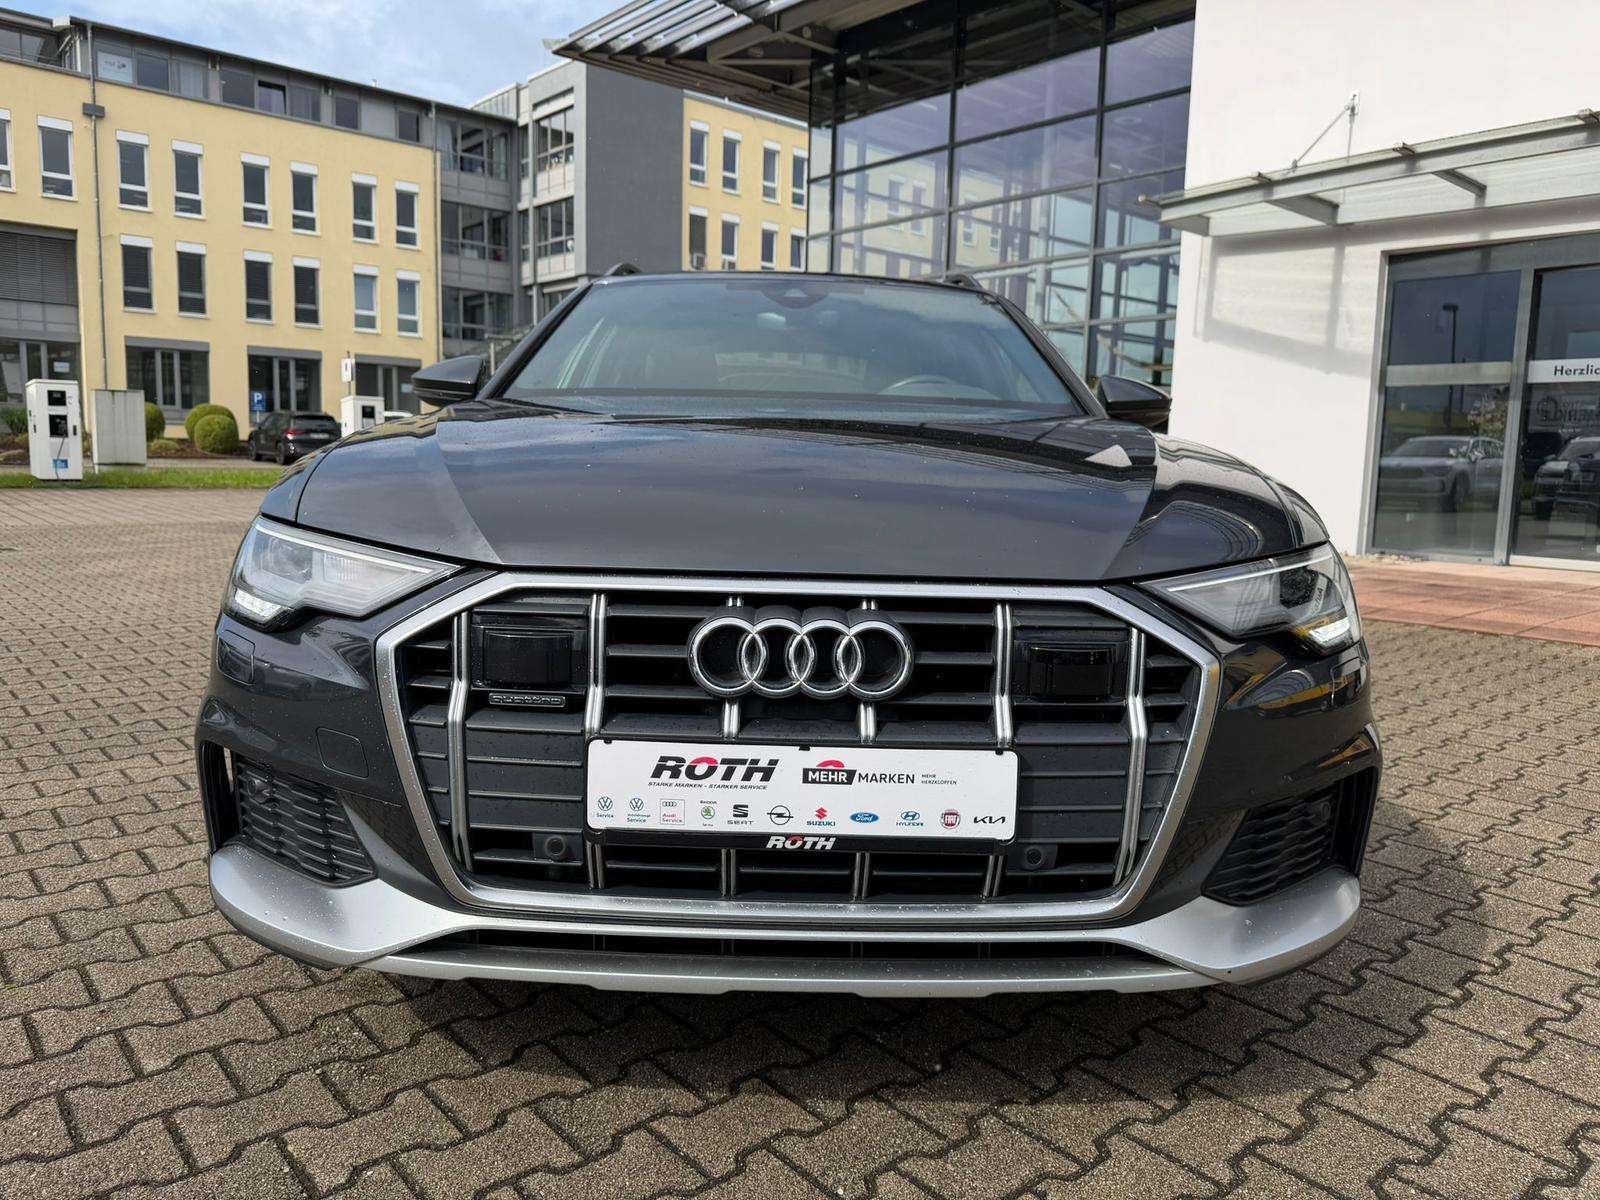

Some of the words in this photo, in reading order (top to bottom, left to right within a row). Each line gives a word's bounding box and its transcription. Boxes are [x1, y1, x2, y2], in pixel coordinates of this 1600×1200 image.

[254, 392, 263, 403] P
[650, 755, 780, 782] ROTH
[807, 771, 848, 783] MEHR
[858, 773, 915, 785] MARKEN
[766, 835, 836, 850] ROTH
